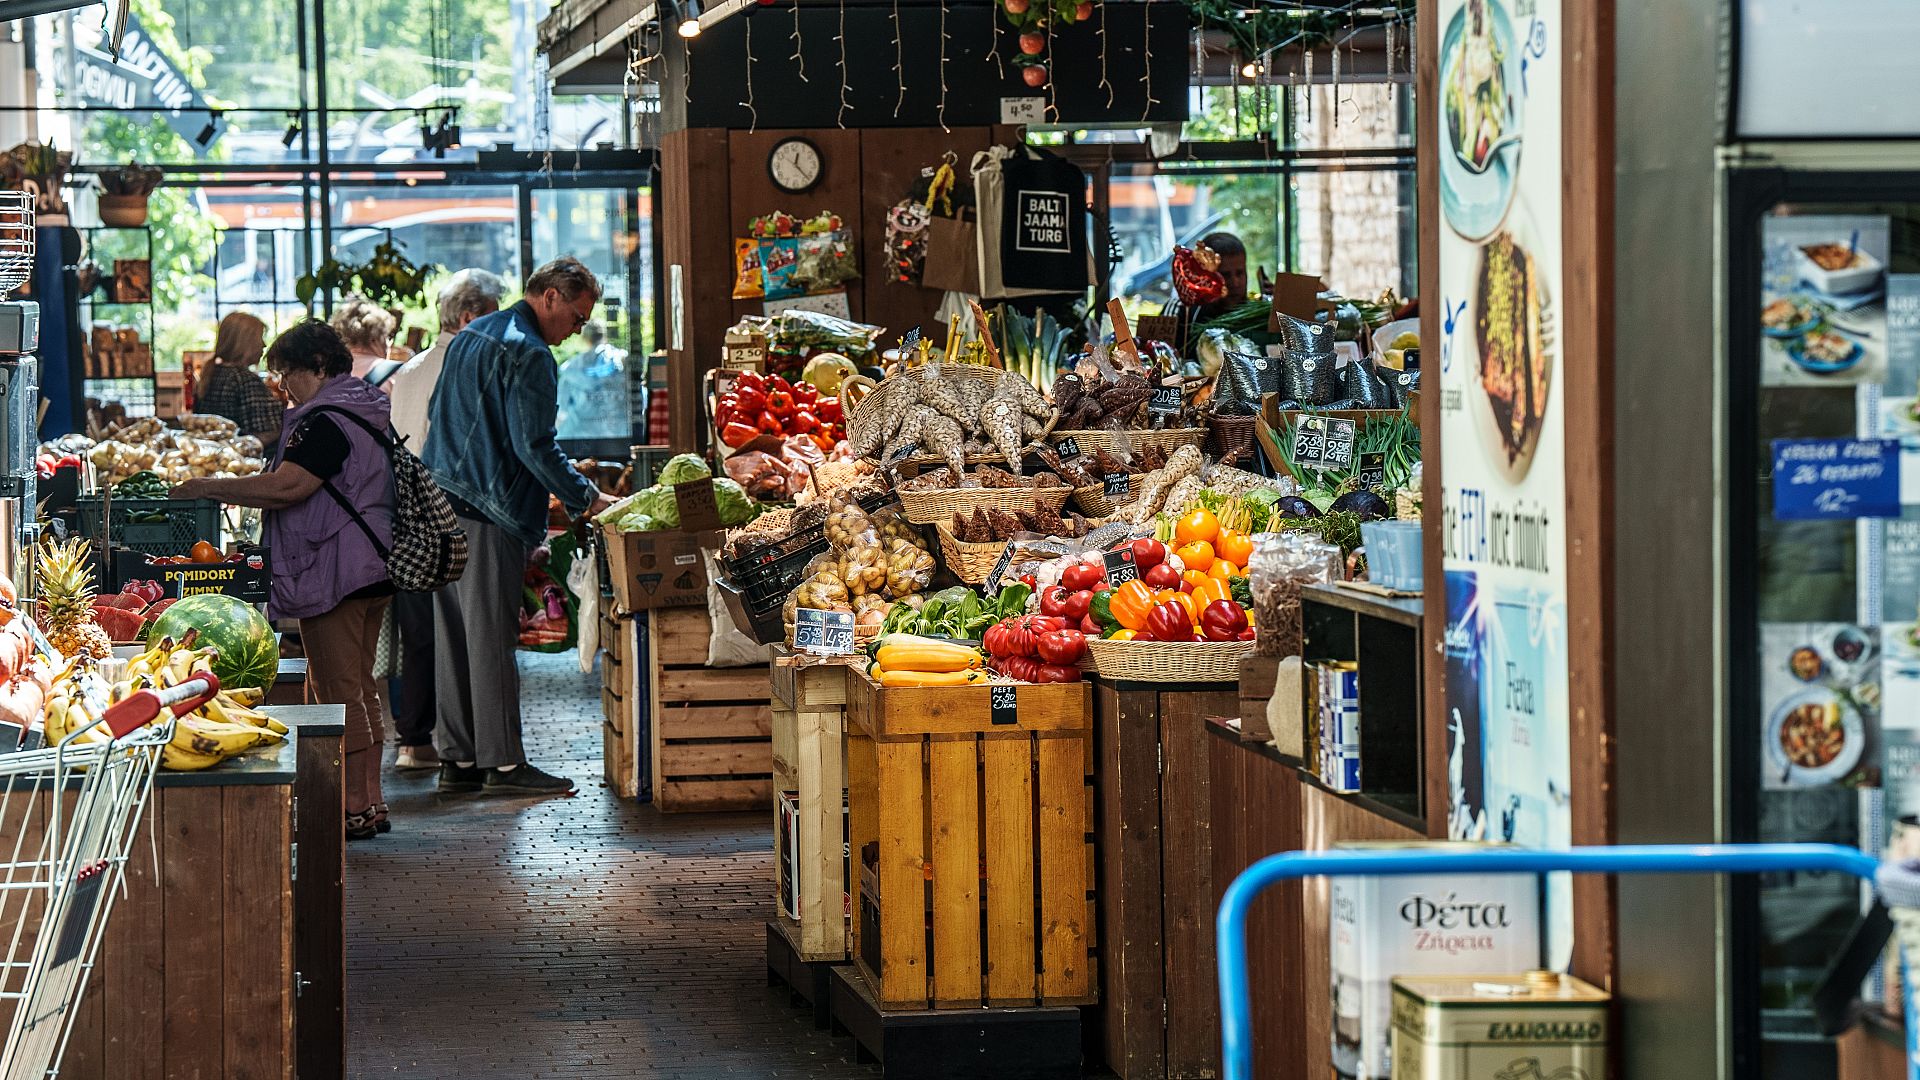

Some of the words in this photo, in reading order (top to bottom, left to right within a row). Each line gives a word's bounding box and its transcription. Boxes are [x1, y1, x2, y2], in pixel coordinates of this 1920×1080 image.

[1029, 199, 1063, 213] BALT
[1029, 228, 1062, 242] TURG
[165, 568, 236, 581] POMIDORY
[1400, 892, 1512, 930] Φέτα
[1488, 1023, 1601, 1040] ΕΛΑΙΟΛΑΔΟ
